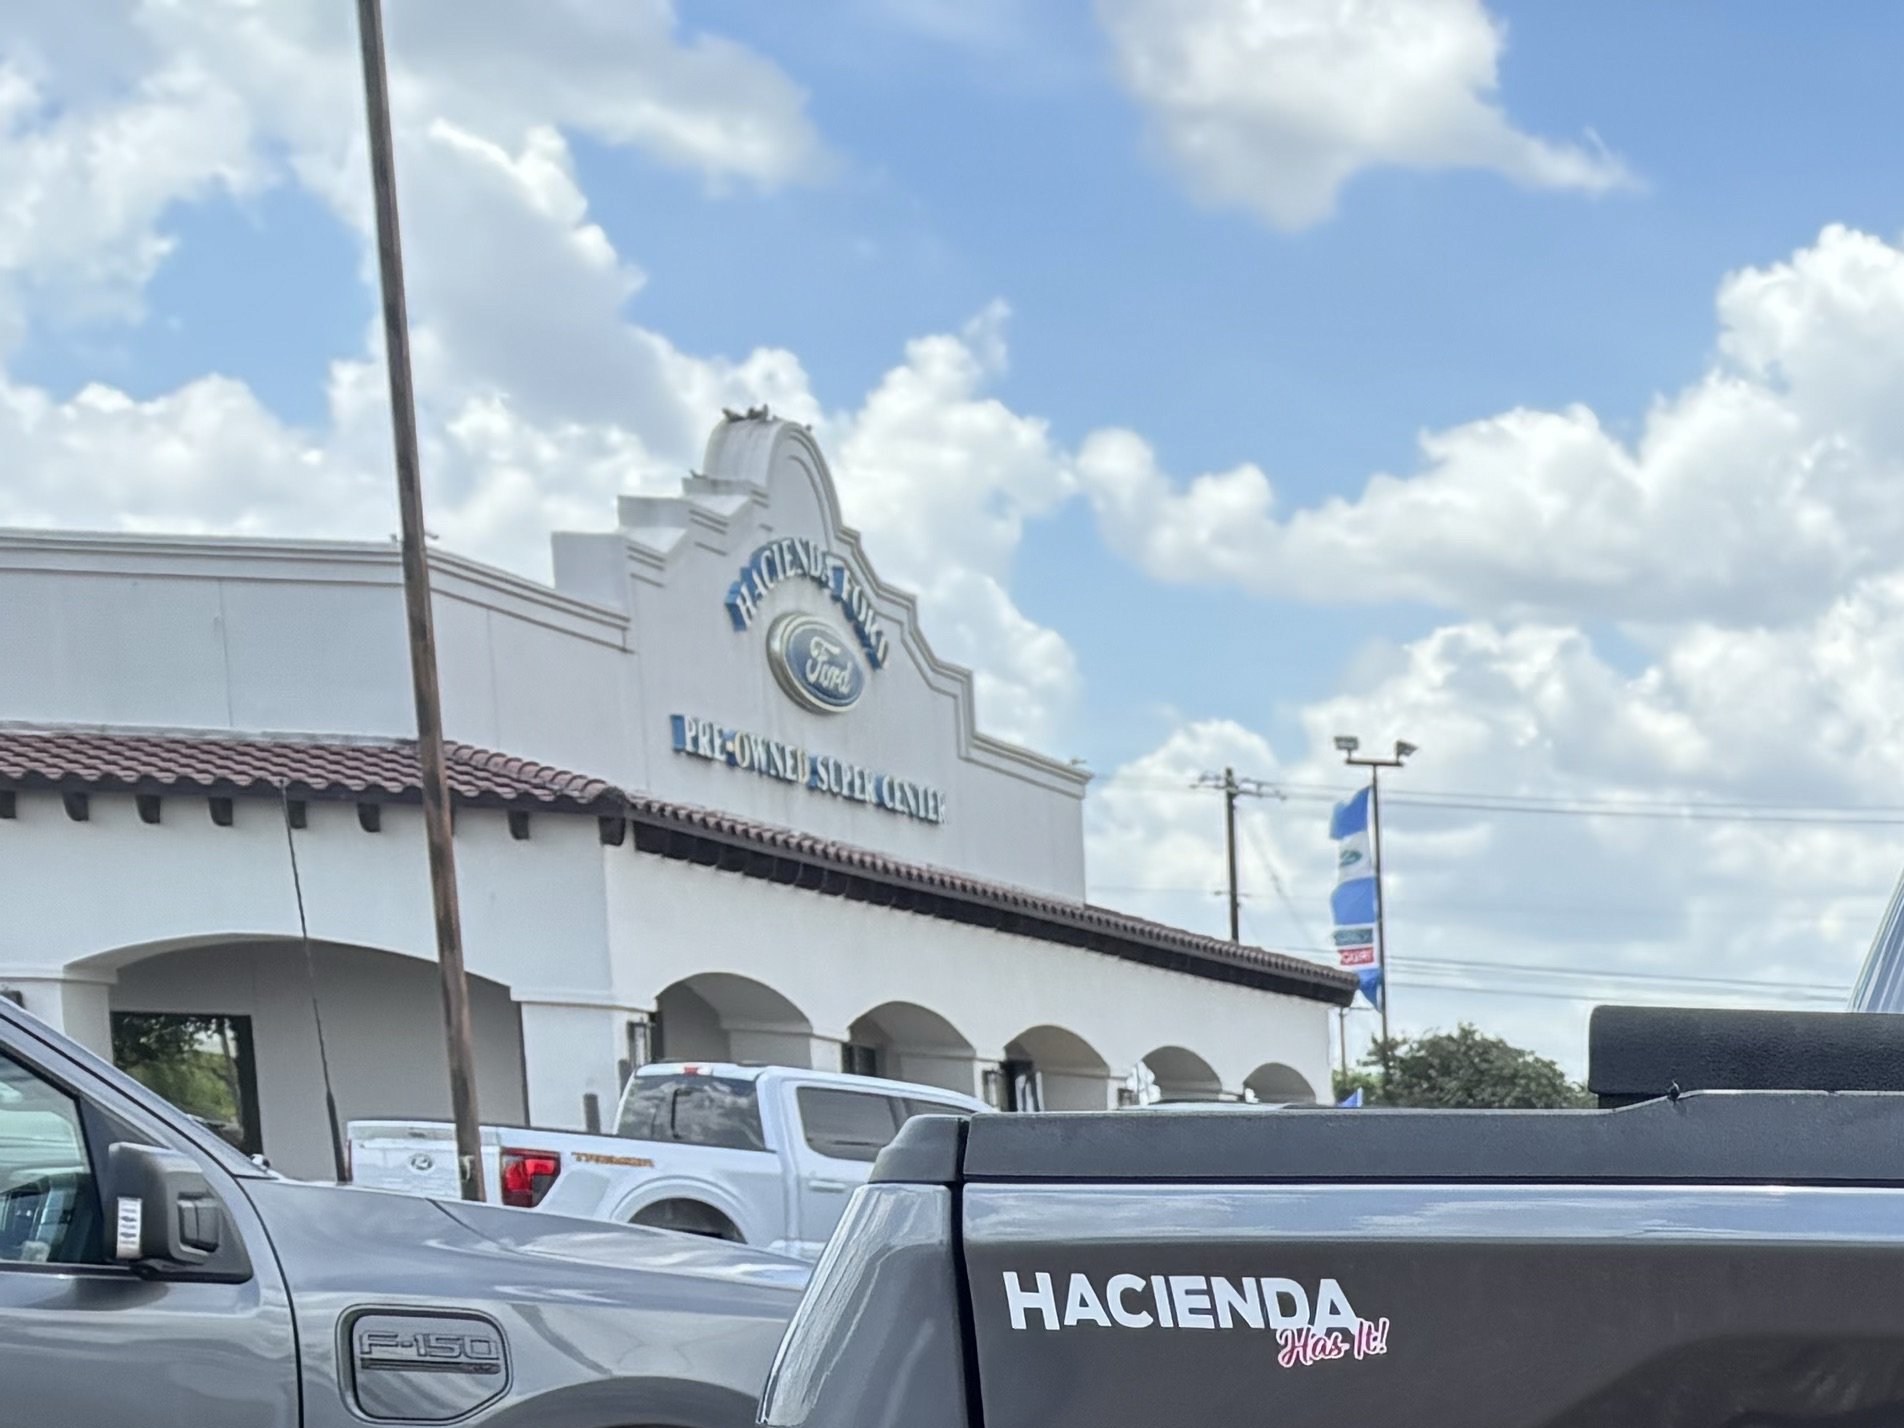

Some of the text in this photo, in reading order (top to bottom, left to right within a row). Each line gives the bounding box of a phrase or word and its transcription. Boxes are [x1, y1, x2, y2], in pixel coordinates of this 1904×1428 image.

[729, 536, 844, 628] HACIENDA
[805, 635, 854, 695] Ford
[680, 714, 948, 823] PRE-OWNED SUPER CENTER
[1002, 1271, 1359, 1336] HACIENDA
[360, 1330, 500, 1361] F-150
[1276, 1317, 1390, 1368] Has It!
